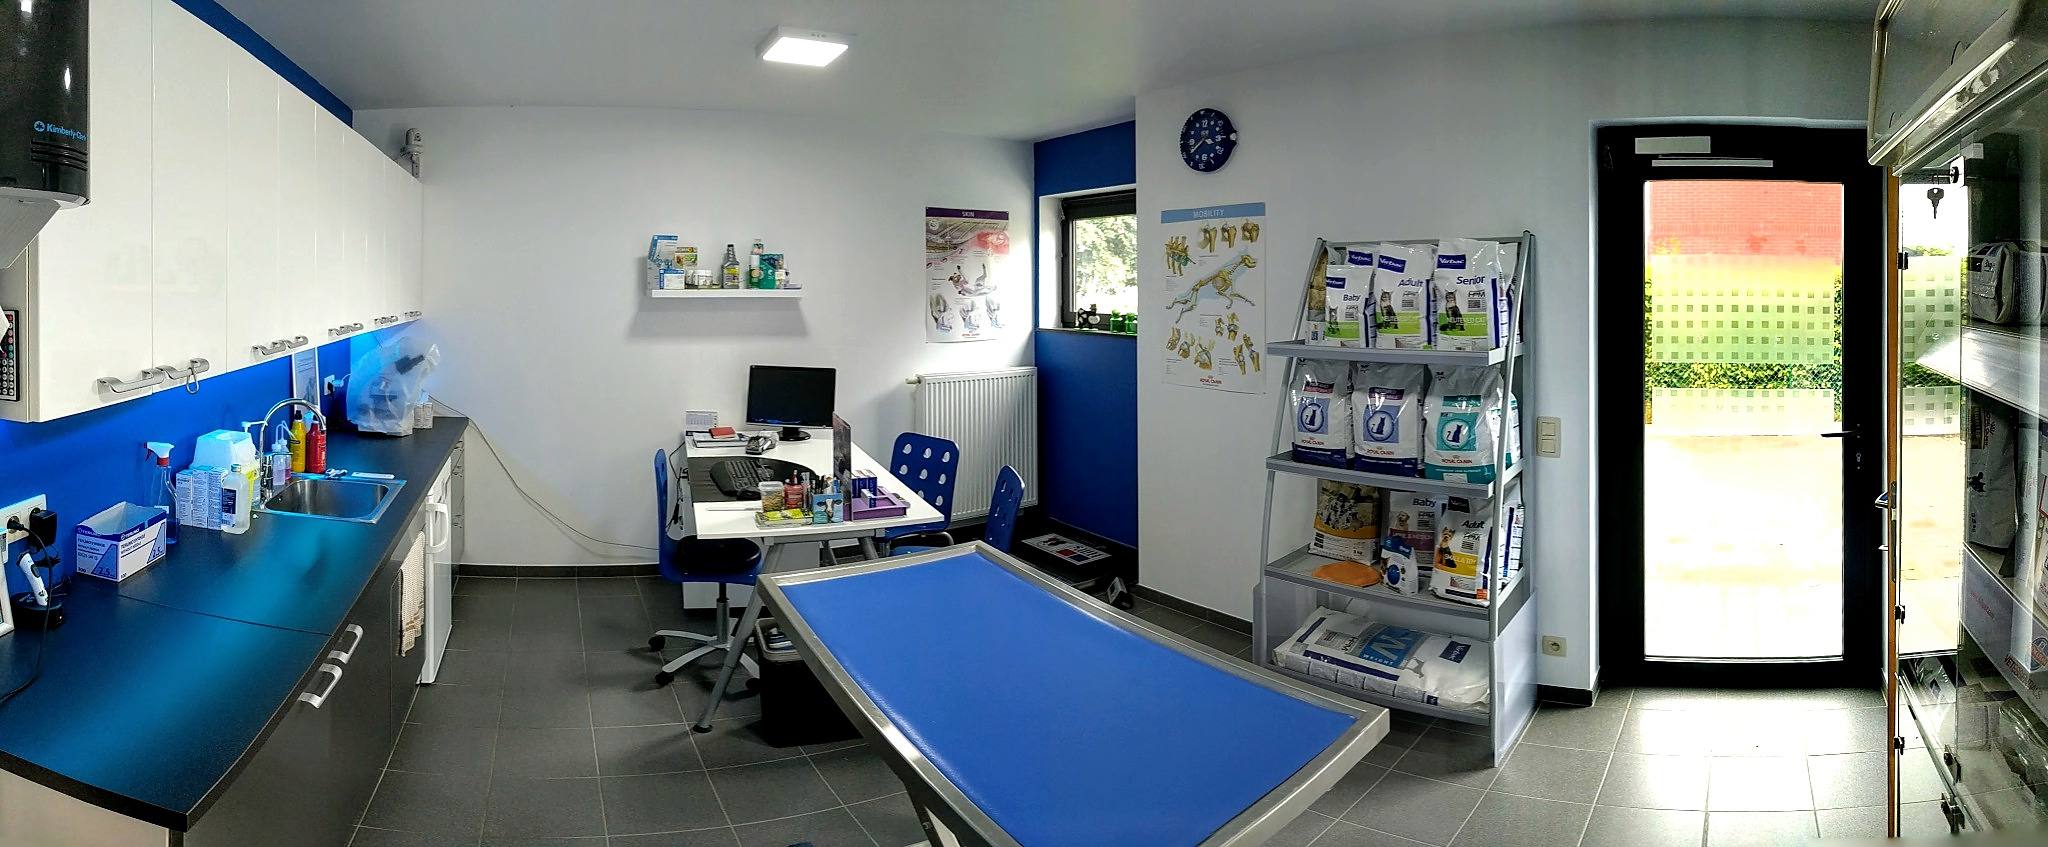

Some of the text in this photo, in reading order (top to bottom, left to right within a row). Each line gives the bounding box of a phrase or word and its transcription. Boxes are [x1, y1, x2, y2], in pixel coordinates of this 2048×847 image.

[1193, 208, 1225, 219] MOBILITY
[1438, 257, 1465, 265] Virbac
[1397, 277, 1424, 288] Adult
[1455, 275, 1486, 286] Senior
[1343, 293, 1362, 302] Baby
[1412, 498, 1437, 508] Baby
[1461, 520, 1486, 529] Adult
[1362, 653, 1394, 667] WEIGHT
